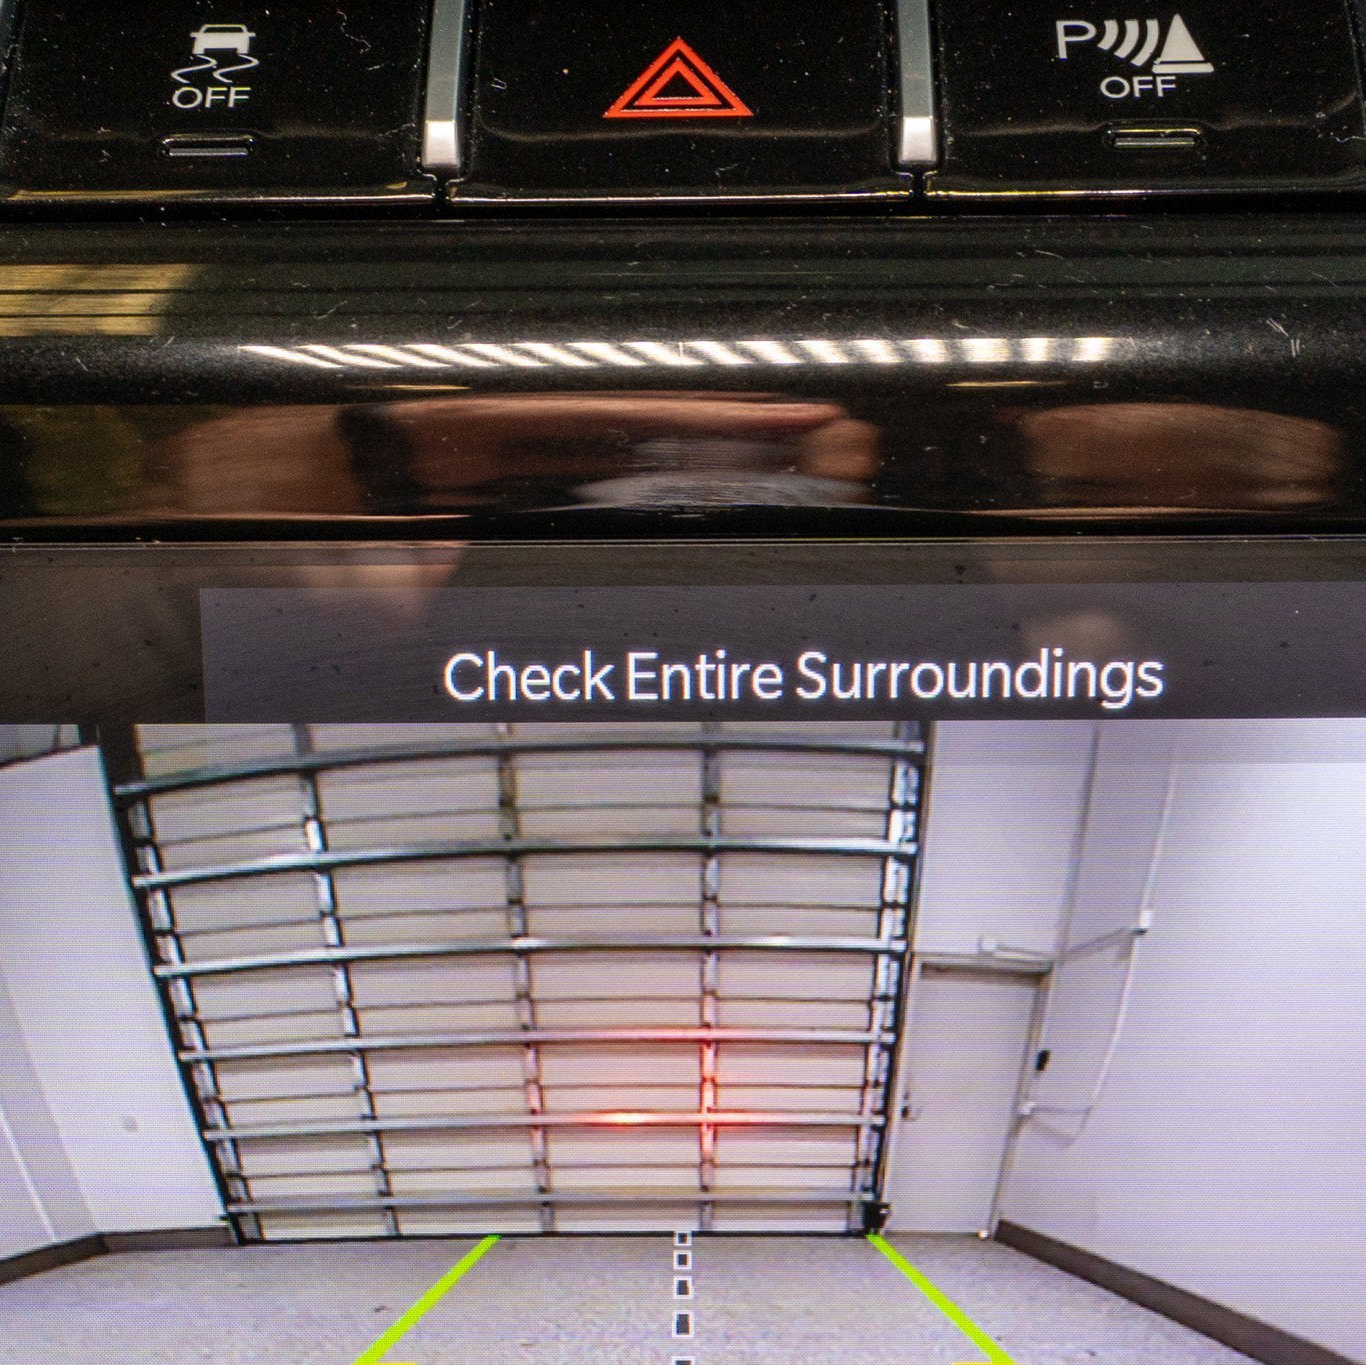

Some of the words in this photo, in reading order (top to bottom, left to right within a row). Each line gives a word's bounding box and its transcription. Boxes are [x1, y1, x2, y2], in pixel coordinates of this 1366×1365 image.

[1056, 20, 1097, 60] P
[172, 86, 252, 109] OFF
[1100, 76, 1177, 99] OFF
[444, 650, 616, 701] Check
[628, 649, 784, 701] Entire
[795, 647, 1166, 710] Surroundings
